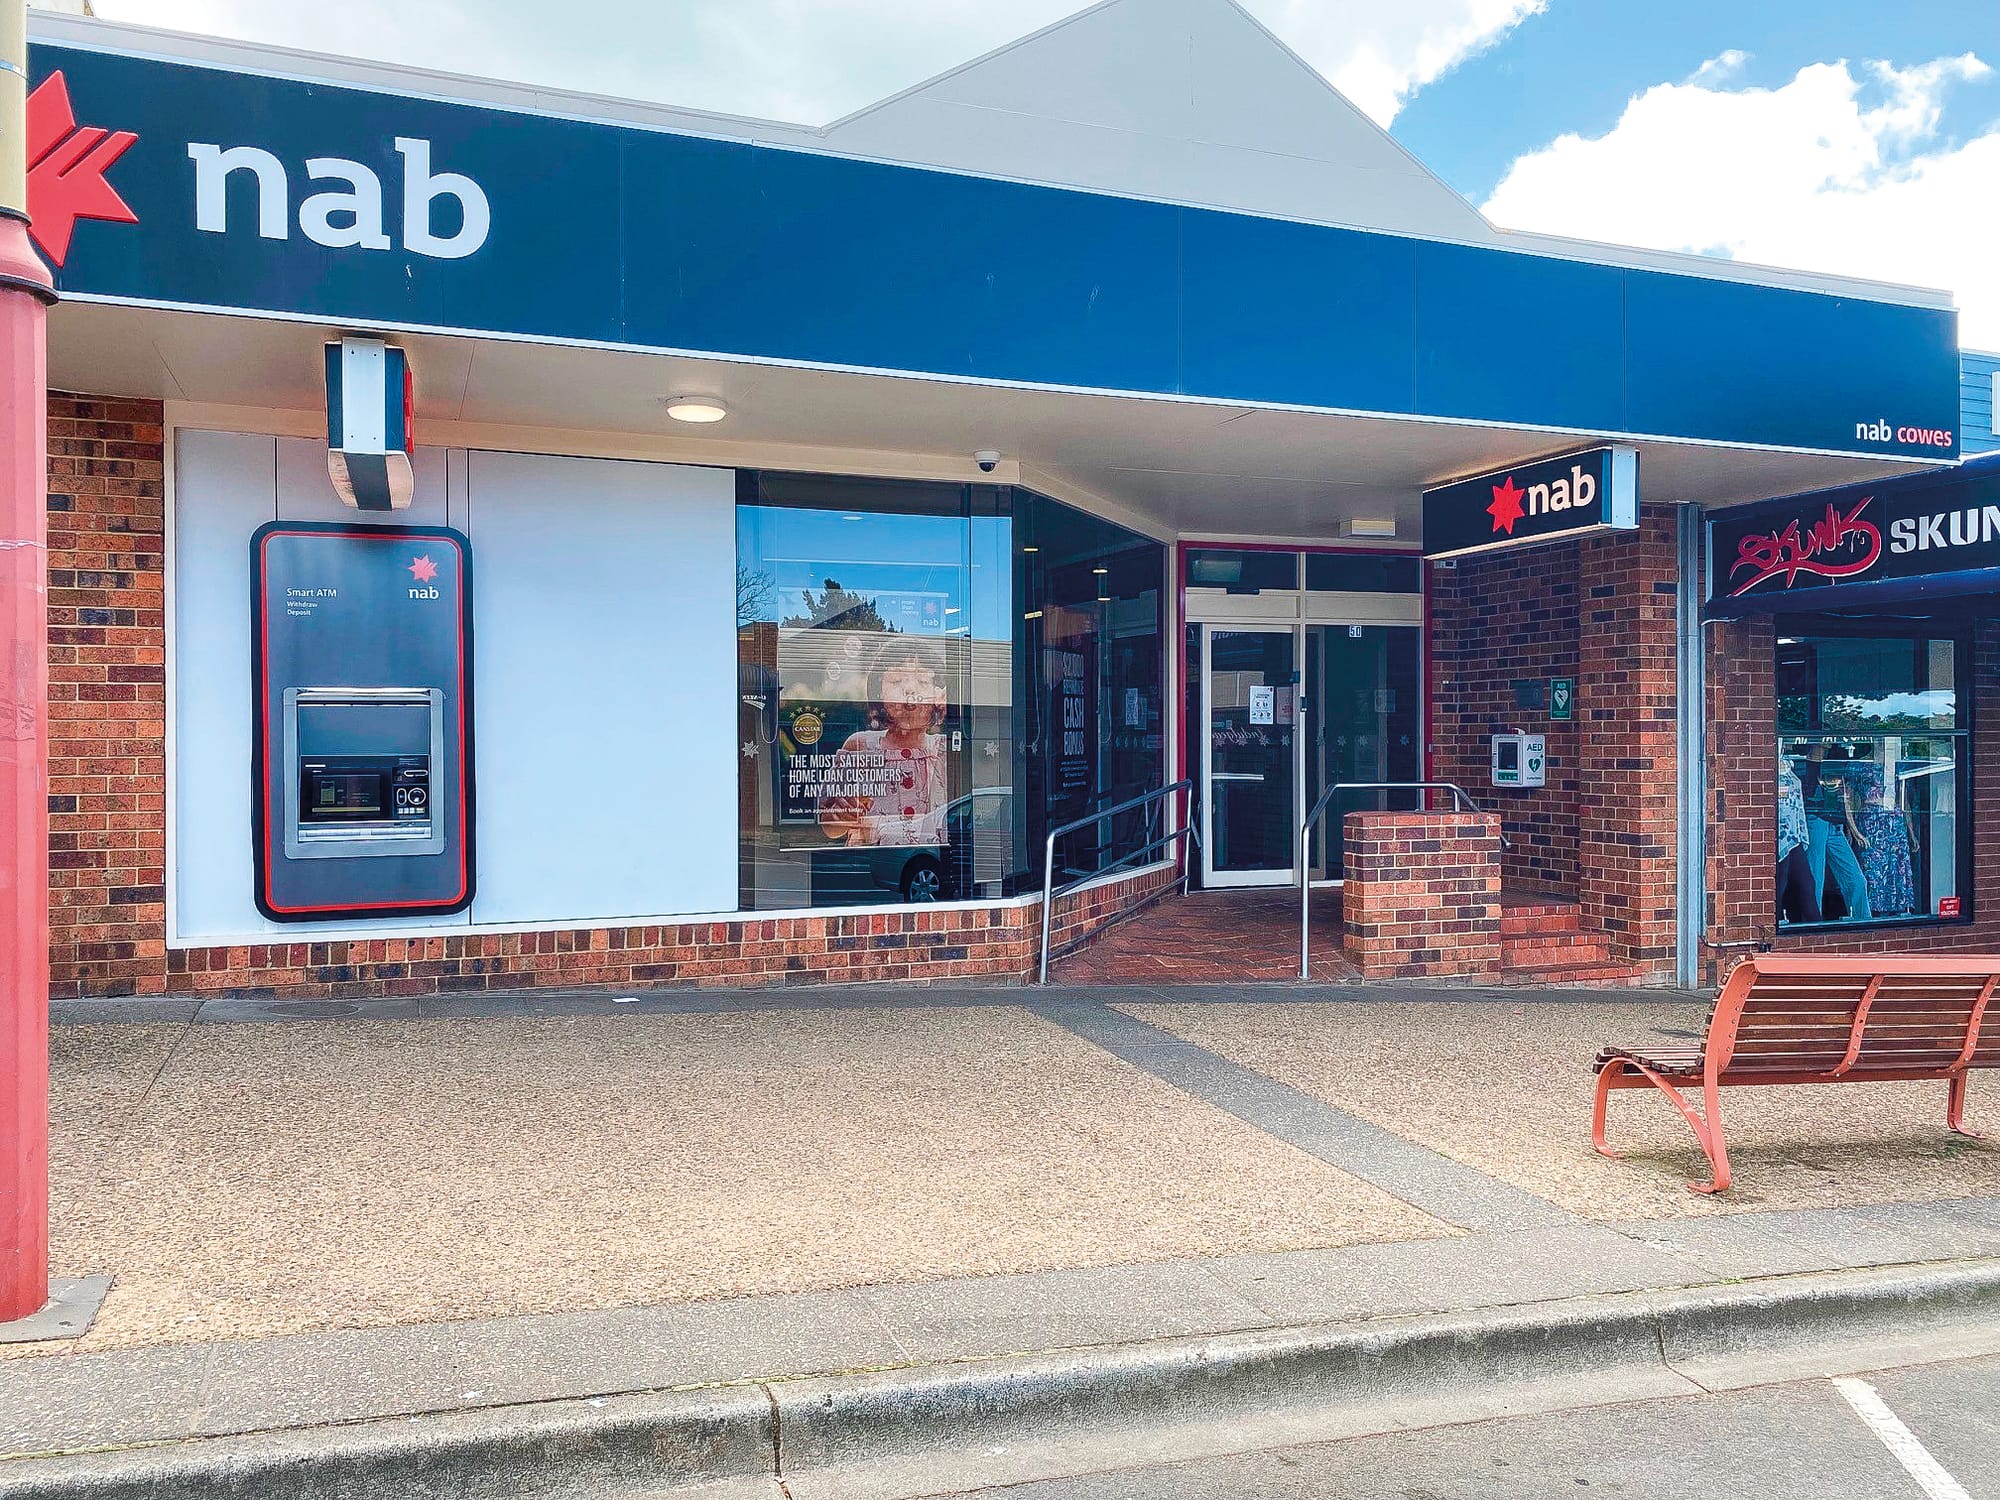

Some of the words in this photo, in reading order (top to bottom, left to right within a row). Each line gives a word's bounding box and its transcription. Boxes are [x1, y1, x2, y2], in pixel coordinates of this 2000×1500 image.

[187, 136, 491, 259] nab
[1856, 418, 1892, 442] nab
[1897, 426, 1953, 447] cowes
[1528, 464, 1596, 516] nab
[286, 588, 314, 598] Smart
[316, 588, 337, 598] ATM
[408, 584, 440, 599] nab
[923, 618, 939, 626] nab
[1350, 626, 1361, 637] 50
[1063, 697, 1084, 729] CASH
[1063, 731, 1084, 756] BONUS
[1527, 743, 1543, 752] AED
[789, 754, 807, 769] THE
[810, 754, 837, 768] MOST
[840, 754, 885, 768] SATISFIED
[789, 768, 816, 783] HOME
[819, 769, 843, 783] LOAN
[846, 768, 902, 783] CUSTOMERS
[789, 784, 801, 798] OF
[804, 784, 823, 798] ANY
[826, 784, 860, 798] MAJOR
[862, 783, 887, 797] BANK
[813, 807, 847, 815] appointment
